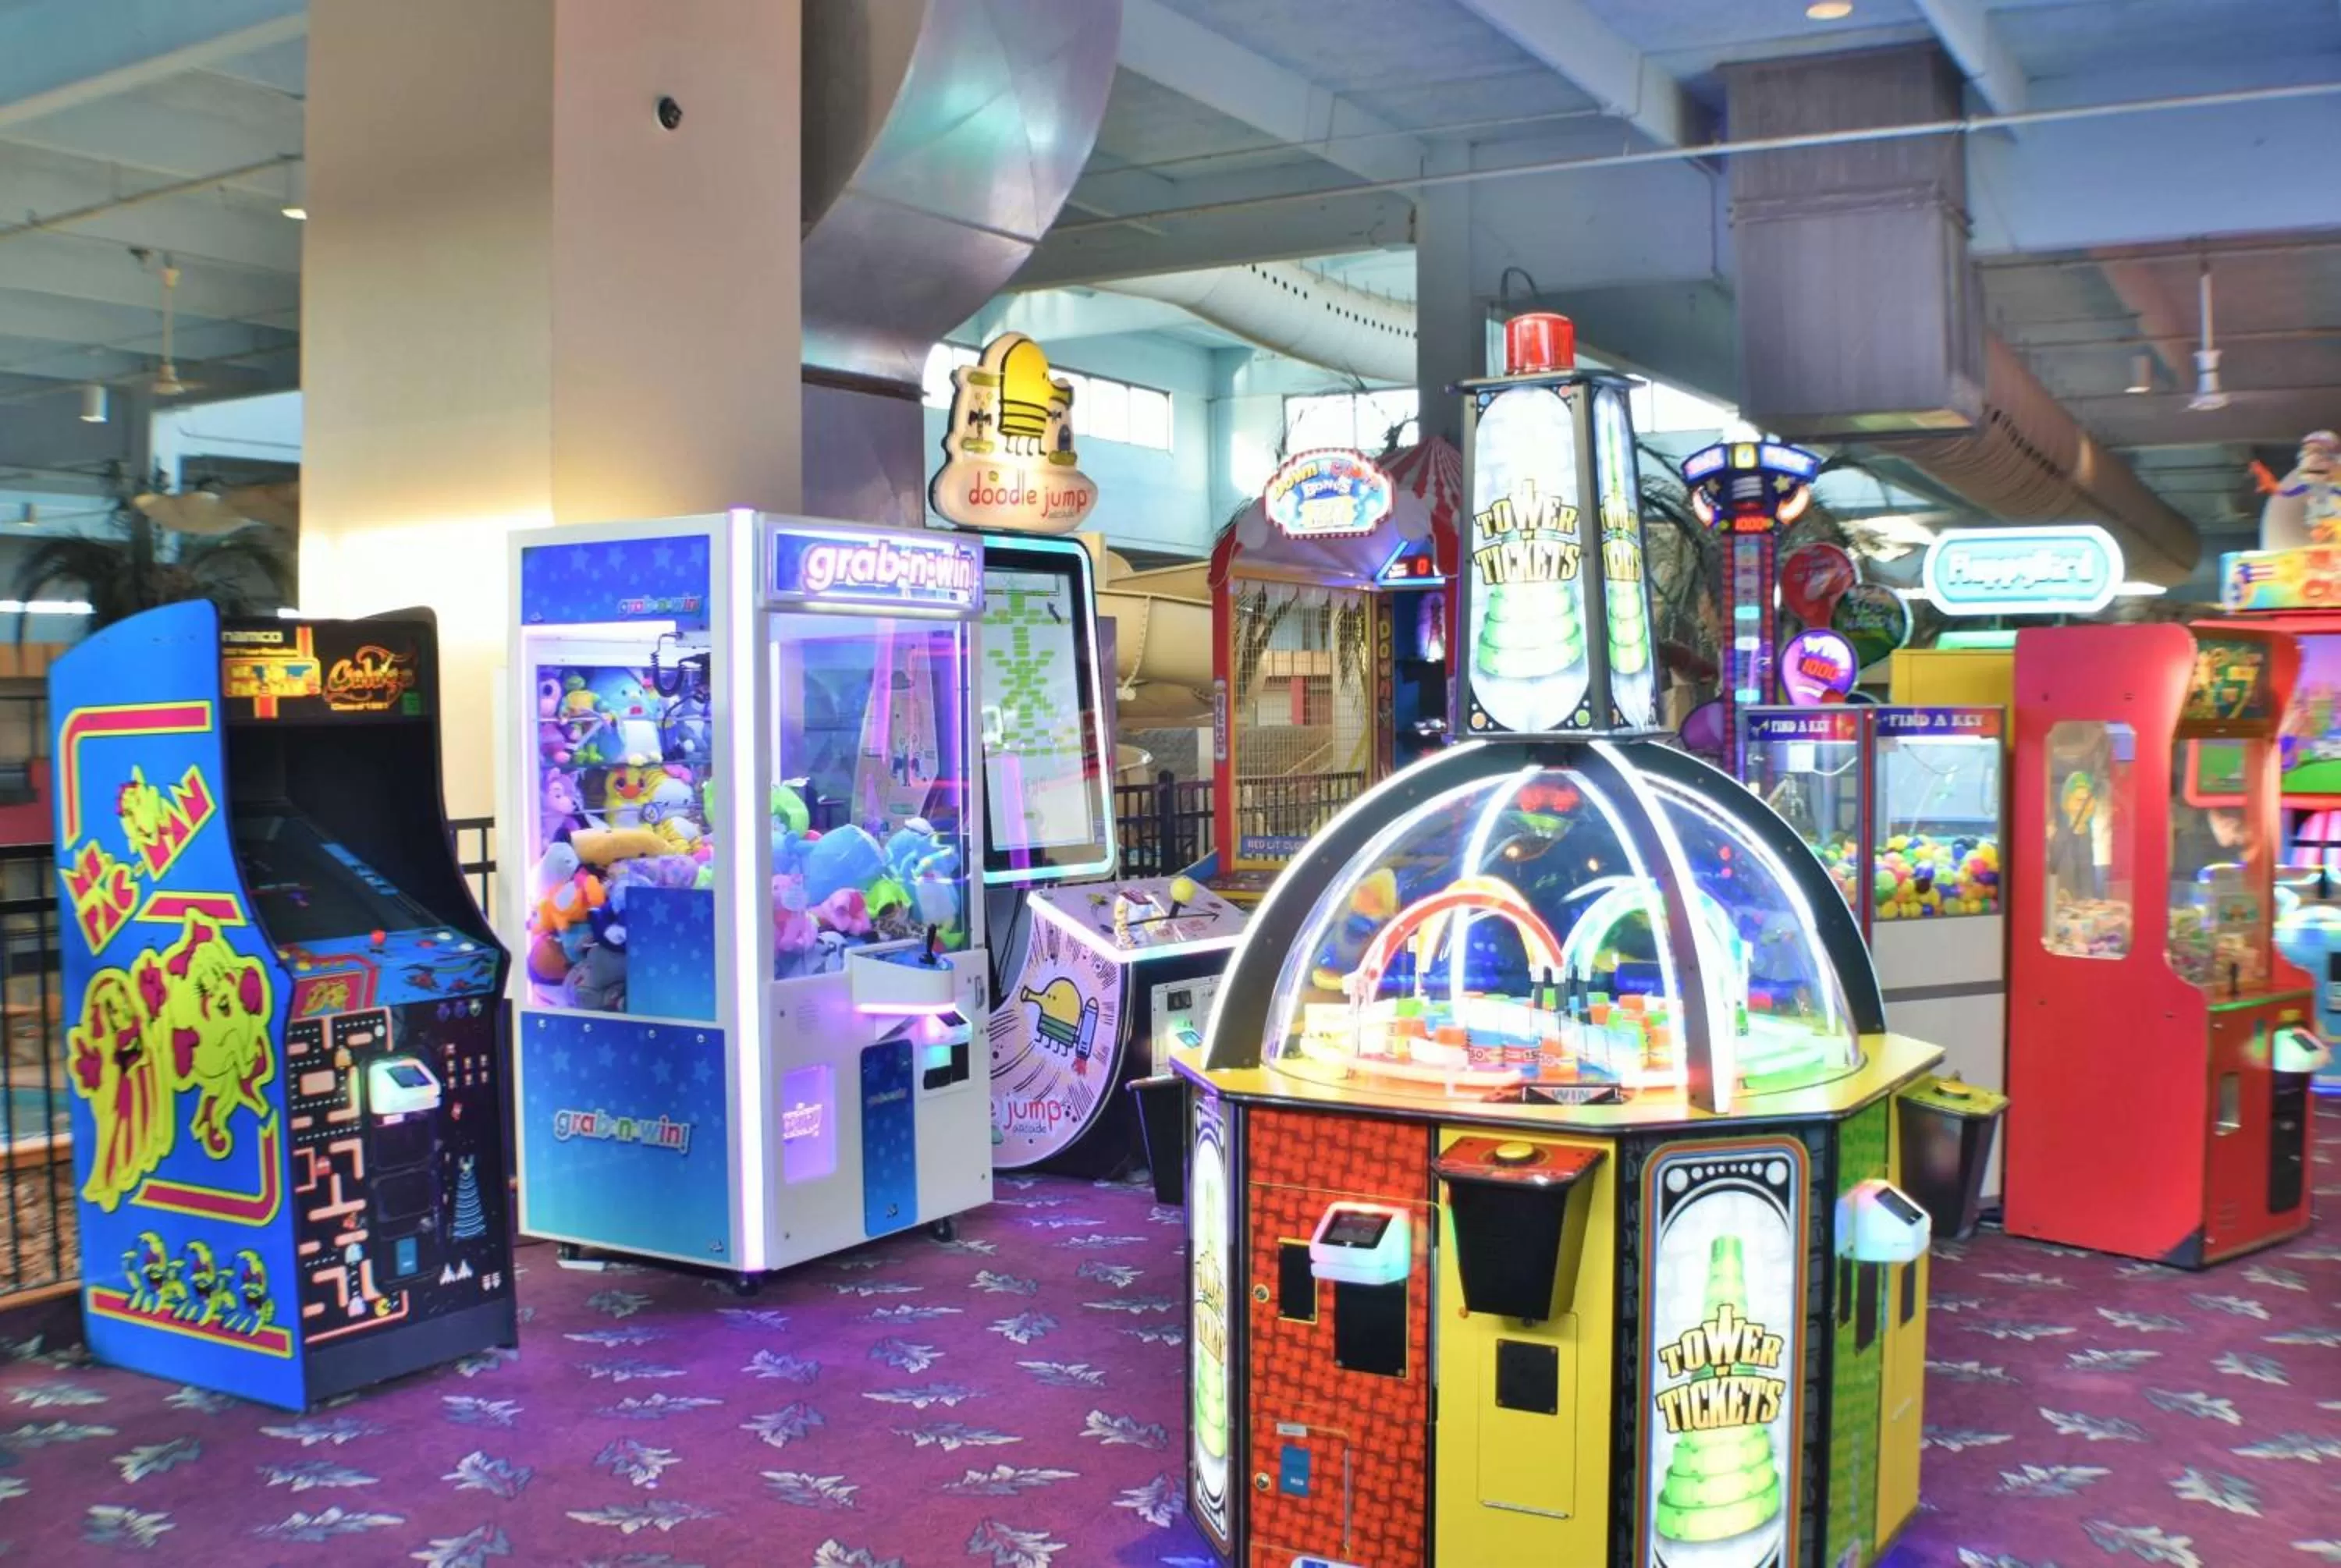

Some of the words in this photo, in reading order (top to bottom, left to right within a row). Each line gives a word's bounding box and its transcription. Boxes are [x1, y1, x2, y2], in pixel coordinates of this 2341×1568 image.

[968, 470, 1037, 506] doodle
[1040, 486, 1087, 518] jump
[1474, 478, 1579, 540] TOWER
[1473, 537, 1581, 585] TICKETS
[1889, 714, 1931, 727] FIND
[1934, 714, 1948, 726] A
[1952, 713, 1986, 726] KEY
[1004, 1092, 1061, 1131] jump
[1551, 1089, 1590, 1101] WIN
[1658, 1304, 1785, 1378] TOWER
[1655, 1375, 1786, 1434] TICKETS
